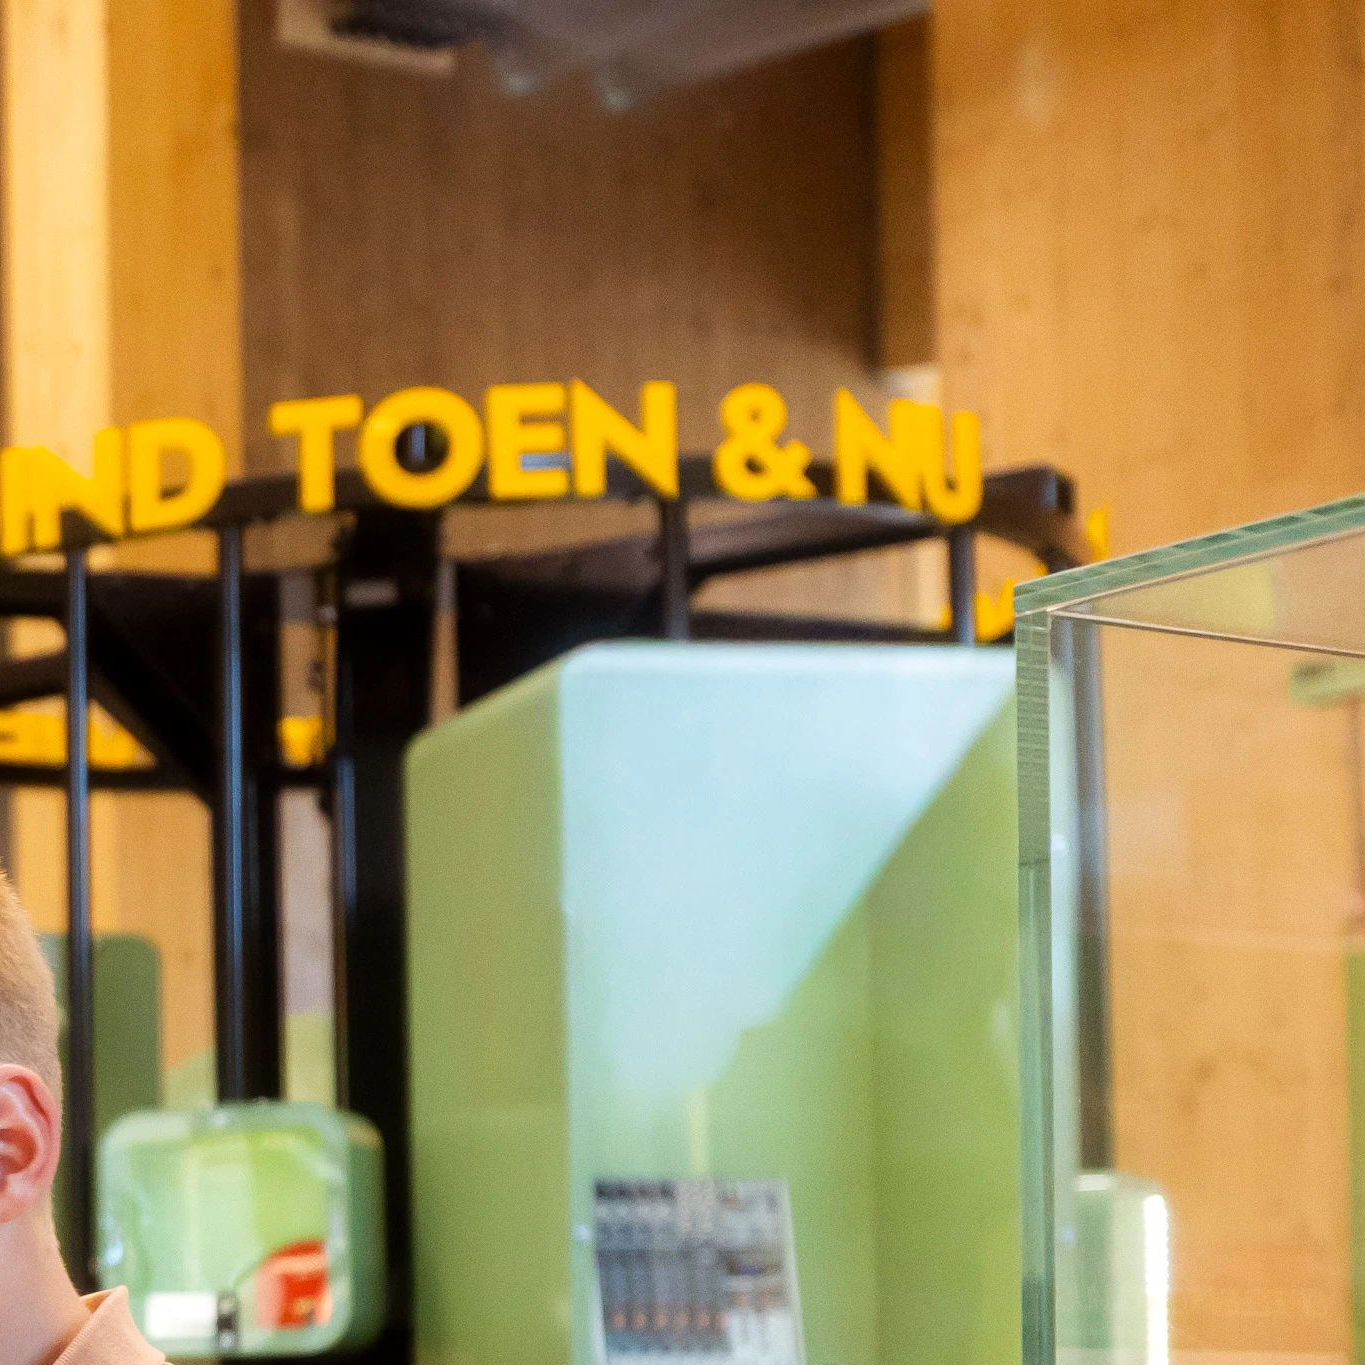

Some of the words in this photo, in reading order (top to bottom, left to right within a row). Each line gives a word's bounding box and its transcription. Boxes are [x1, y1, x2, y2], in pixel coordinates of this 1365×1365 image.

[270, 379, 679, 513] TOEN
[713, 382, 818, 501] &
[834, 387, 985, 524] NU
